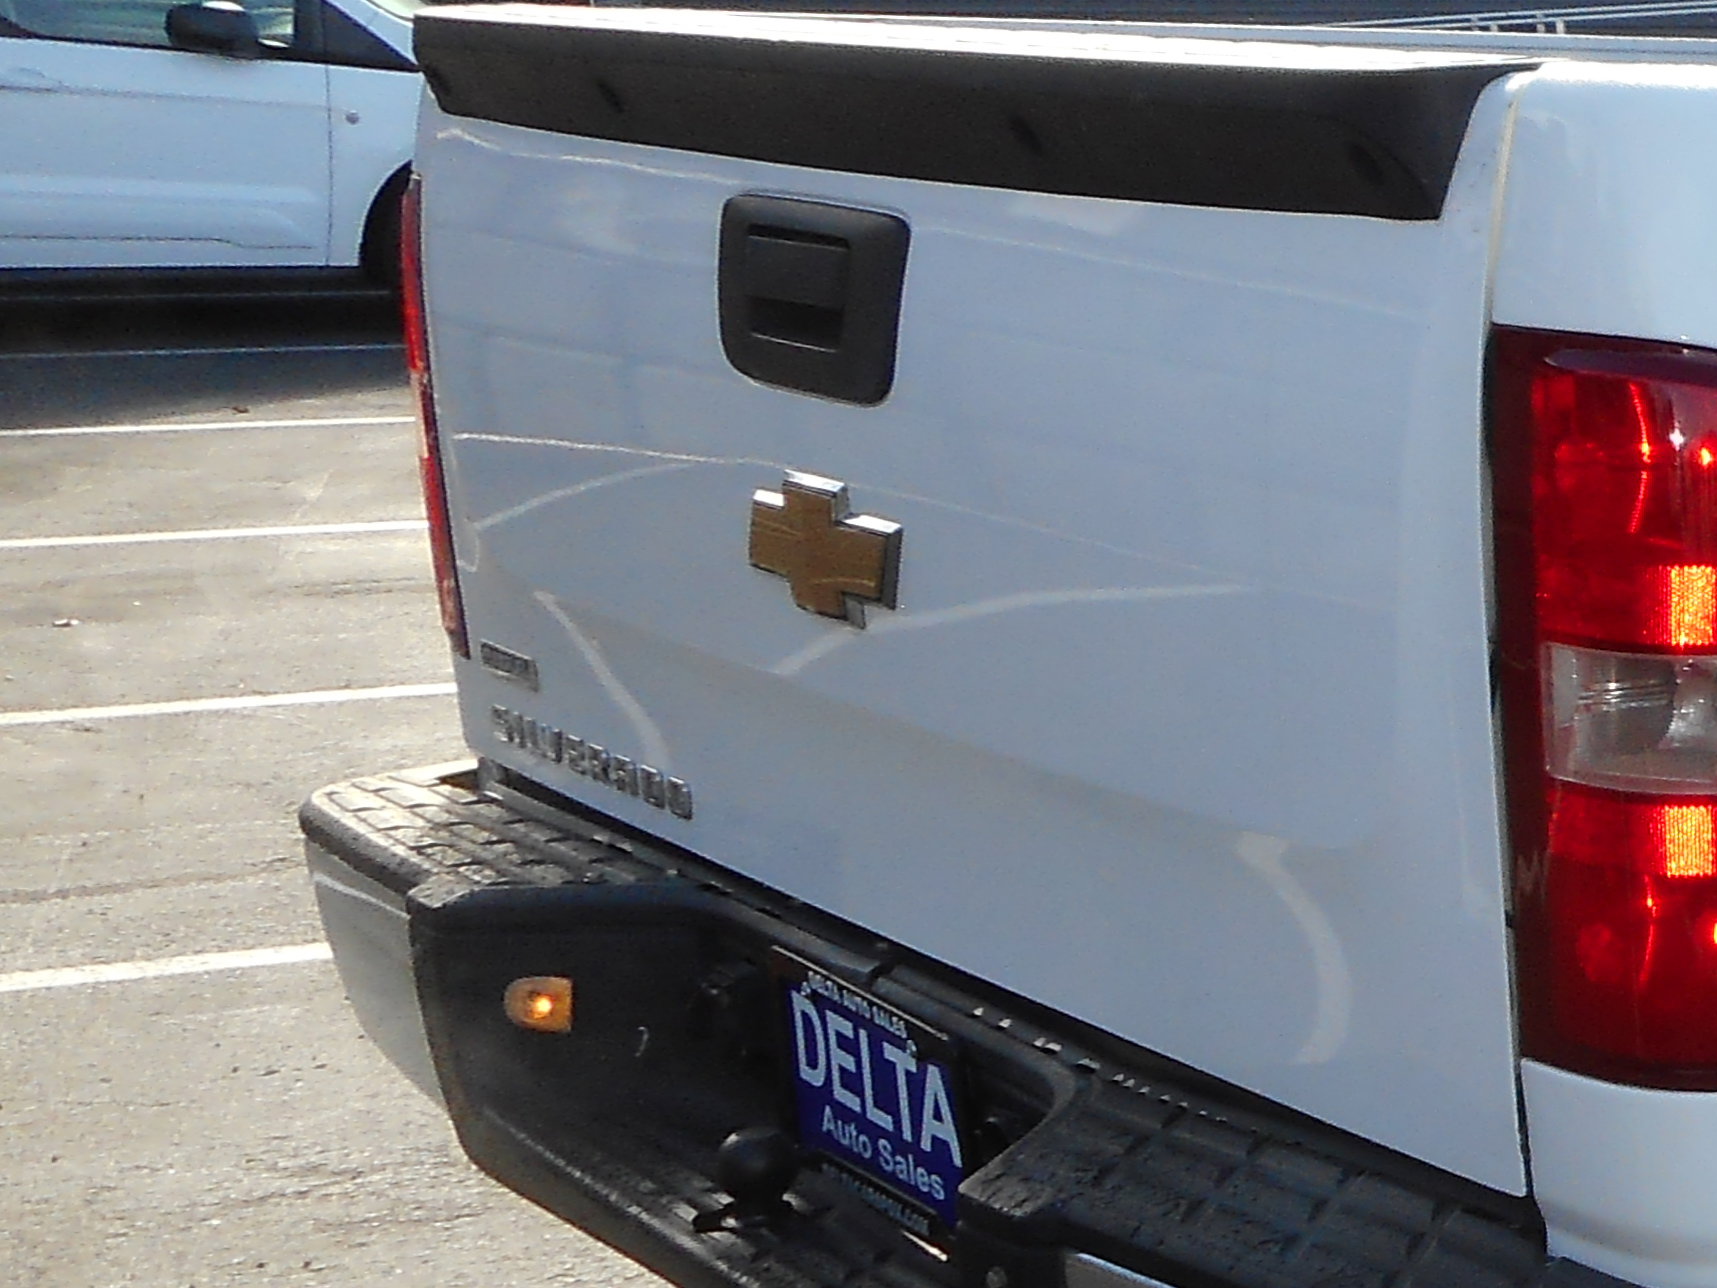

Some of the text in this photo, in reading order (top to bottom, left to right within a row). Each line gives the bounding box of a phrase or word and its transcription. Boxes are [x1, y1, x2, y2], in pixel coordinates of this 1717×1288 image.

[491, 704, 693, 820] SILVERADO
[791, 988, 963, 1168] DELTA
[822, 1104, 872, 1159] Auto
[877, 1137, 945, 1201] Sales
